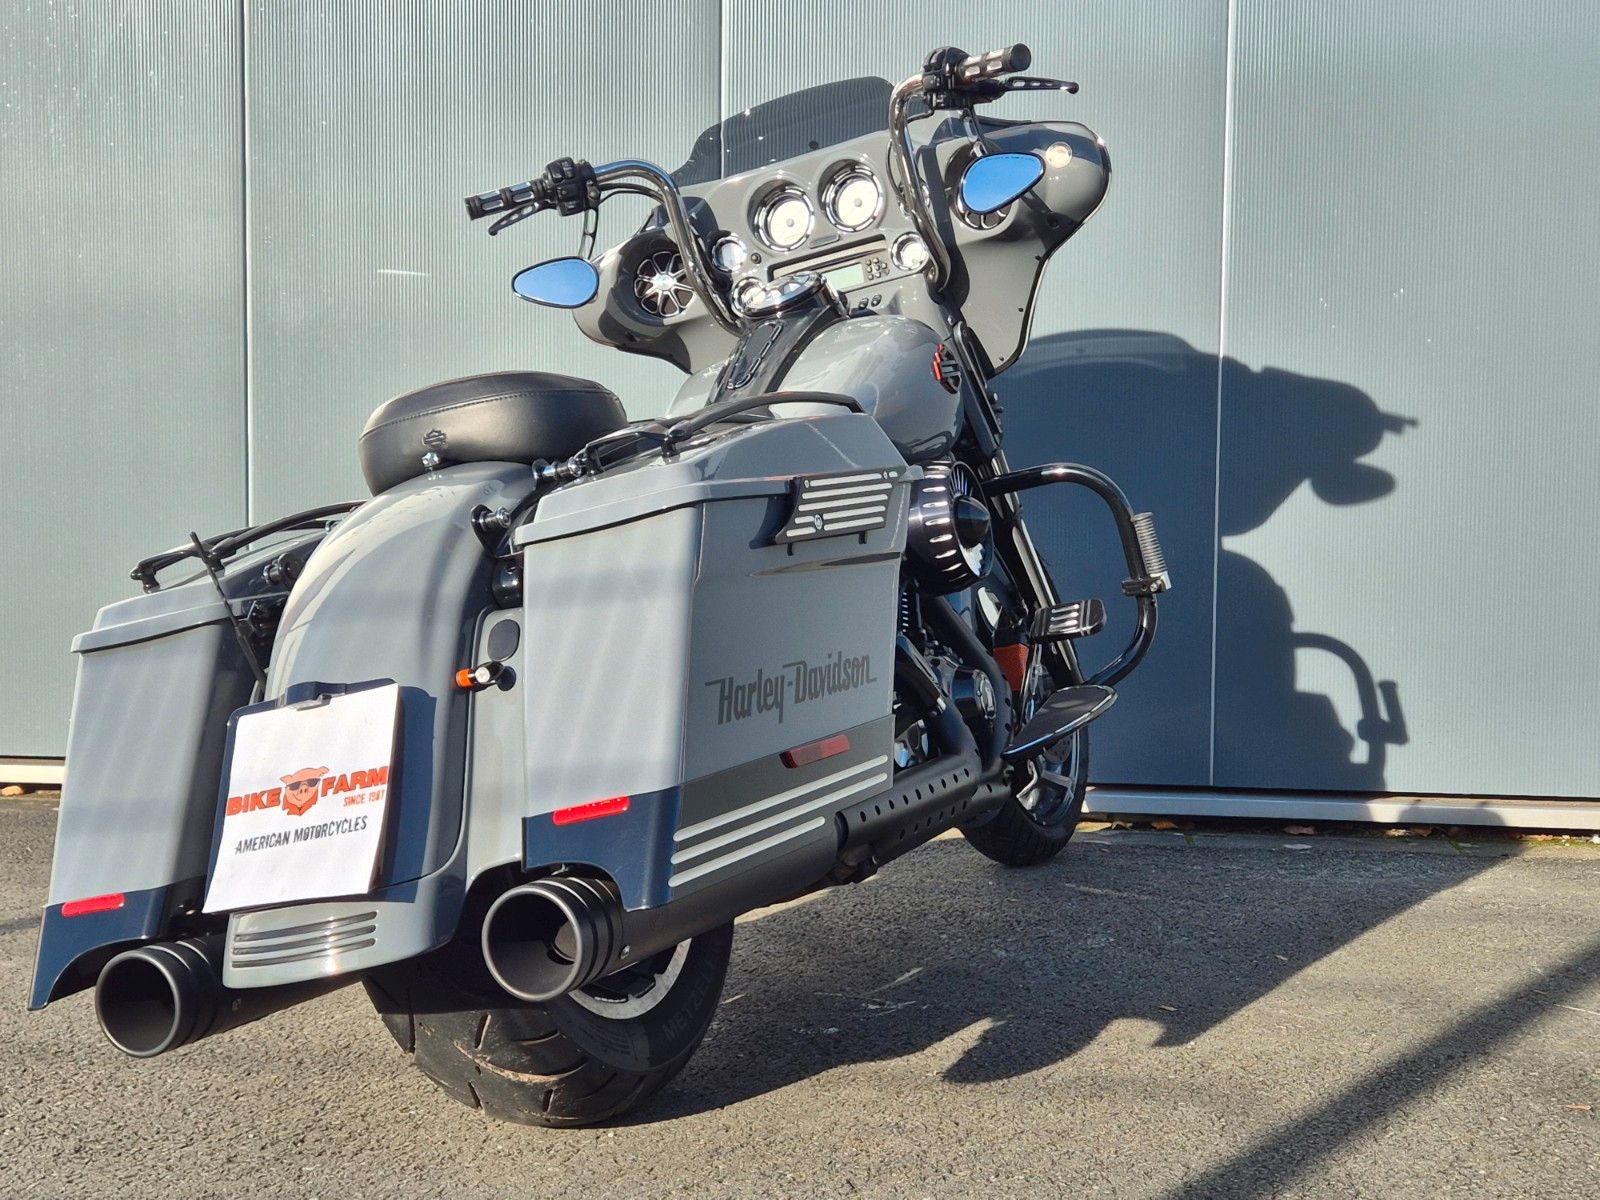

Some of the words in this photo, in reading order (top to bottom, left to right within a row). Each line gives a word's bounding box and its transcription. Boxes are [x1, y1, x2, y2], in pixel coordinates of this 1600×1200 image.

[705, 651, 877, 725] Harley-Davidson
[226, 787, 282, 816] BIKE
[321, 766, 389, 797] FARM
[343, 793, 366, 808] SINCE
[235, 831, 291, 855] AMERICAN
[293, 815, 368, 843] MOTORCYCLES
